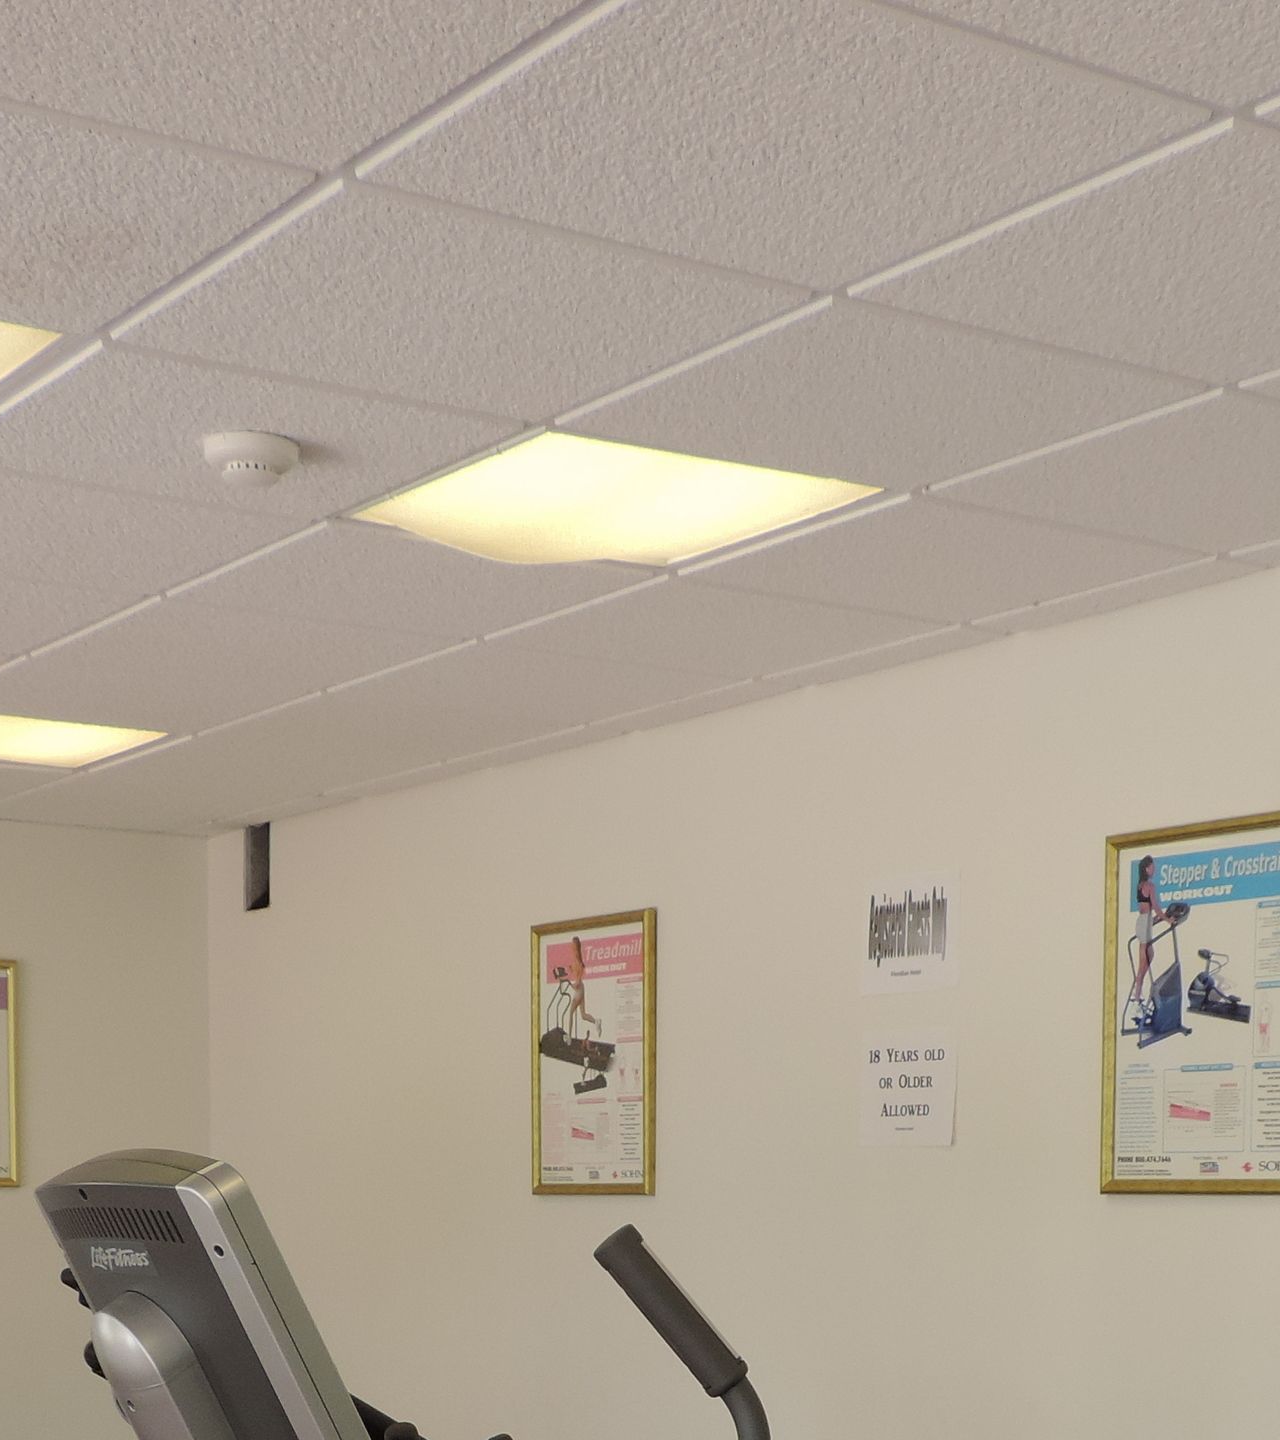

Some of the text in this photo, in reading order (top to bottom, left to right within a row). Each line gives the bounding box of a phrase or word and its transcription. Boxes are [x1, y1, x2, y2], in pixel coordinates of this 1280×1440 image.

[1160, 863, 1208, 887] Stepper
[1211, 863, 1220, 879] &
[1159, 884, 1233, 902] WORKOUT
[584, 938, 643, 961] Treadmill
[585, 962, 627, 975] WORKOUT
[869, 1050, 881, 1064] 18
